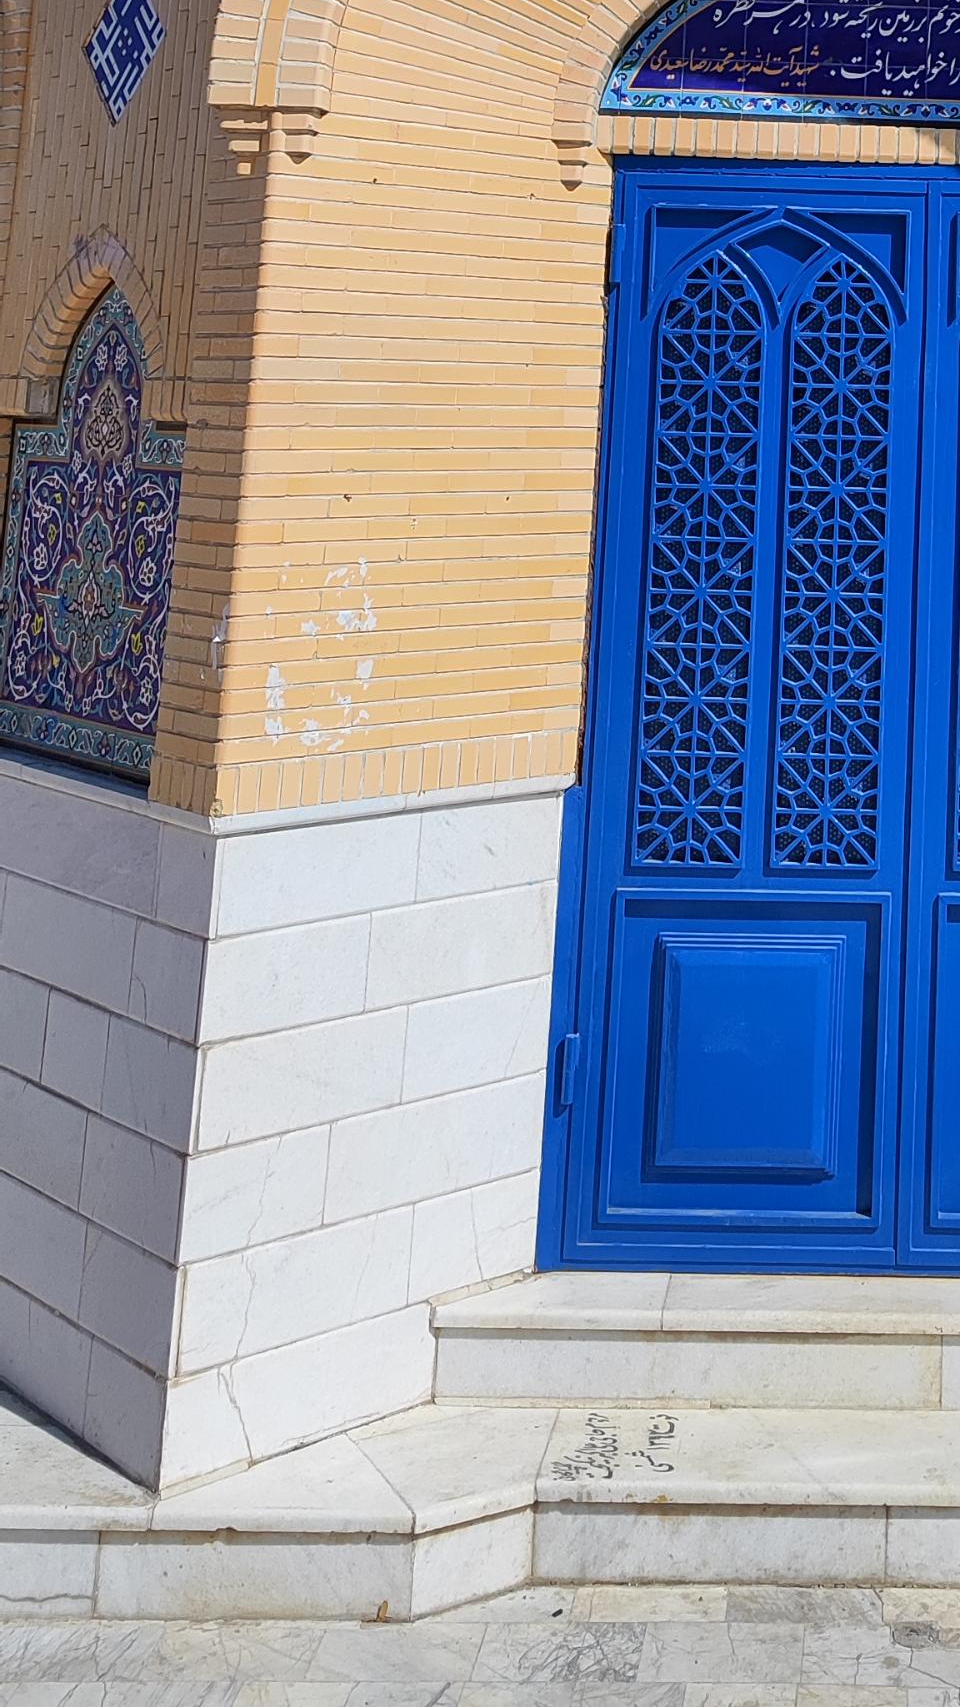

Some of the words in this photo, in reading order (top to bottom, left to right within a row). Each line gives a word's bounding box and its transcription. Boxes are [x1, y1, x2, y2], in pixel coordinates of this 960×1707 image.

[788, 10, 811, 29] در
[911, 14, 928, 44] بر
[650, 49, 689, 80] سعیدی
[689, 47, 714, 73] رضا
[748, 47, 771, 75] الله
[789, 45, 820, 87] شهید
[892, 51, 949, 96] خواهید
[948, 57, 960, 86] را
